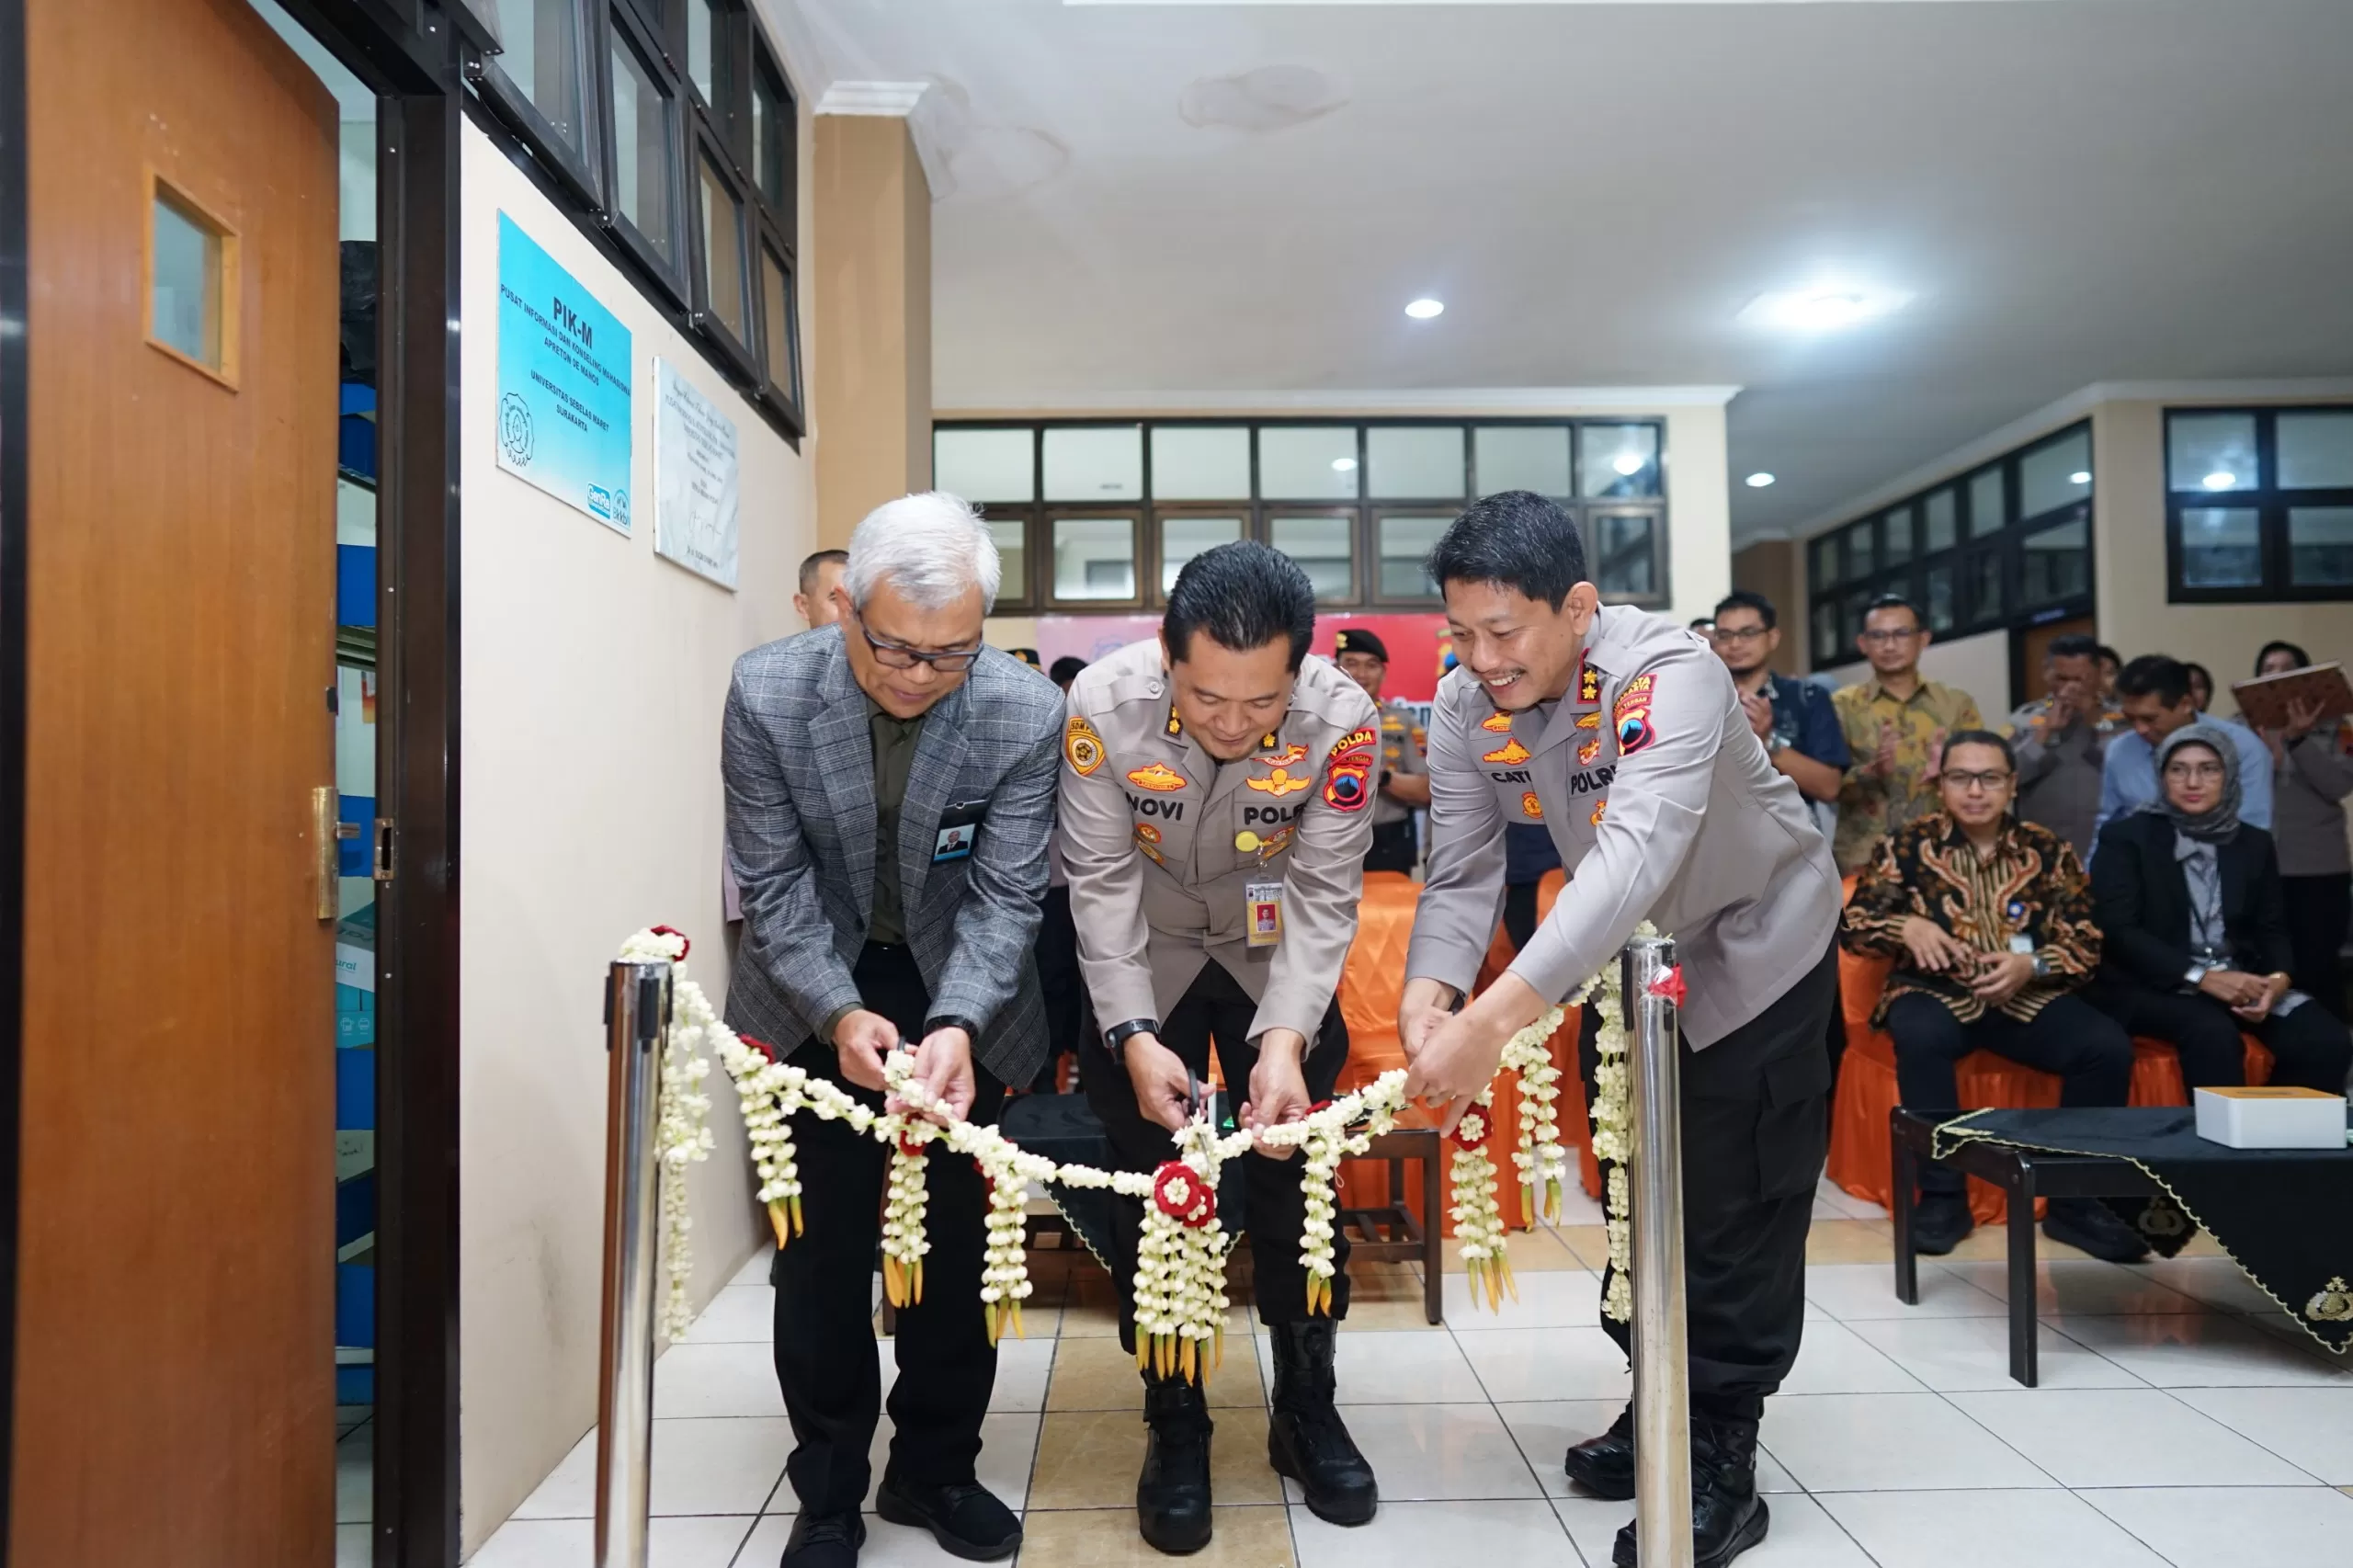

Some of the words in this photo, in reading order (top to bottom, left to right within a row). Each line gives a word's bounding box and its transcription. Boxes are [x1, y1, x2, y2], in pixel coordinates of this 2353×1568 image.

[500, 283, 523, 309] PUSAT
[524, 301, 558, 338] INFORMASI
[558, 331, 571, 348] DAN
[572, 341, 602, 373] KONSELING
[553, 296, 593, 350] PIK-M
[544, 336, 572, 365] APRETON
[580, 364, 599, 387] MANOS
[530, 369, 569, 404] UNIVERSITAS
[569, 396, 592, 420] SEBELAS
[592, 412, 609, 434] MARET
[556, 403, 588, 434] SURAKARTA
[1330, 731, 1373, 757] POLDA
[1125, 791, 1184, 821] NOVI
